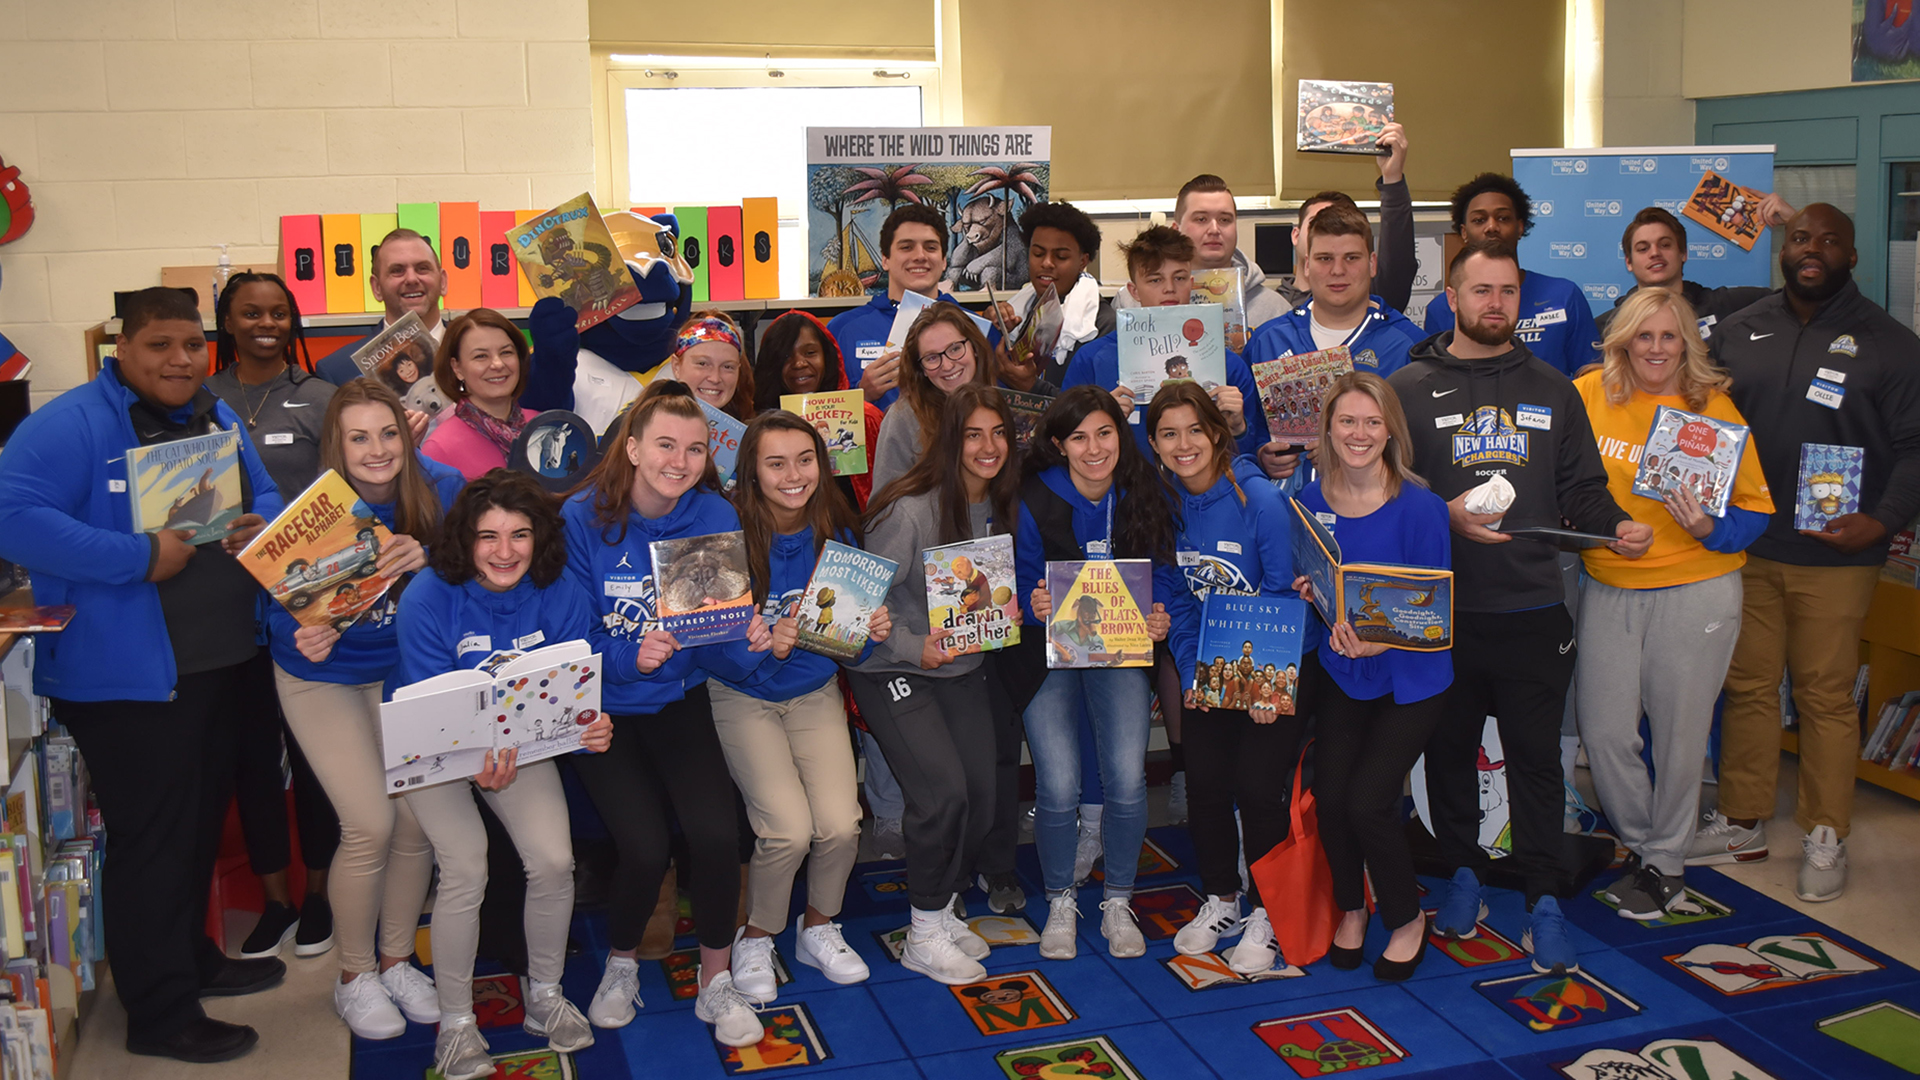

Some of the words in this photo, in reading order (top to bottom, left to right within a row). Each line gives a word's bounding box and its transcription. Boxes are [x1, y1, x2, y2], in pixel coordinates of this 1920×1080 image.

[824, 134, 875, 157] WHERE
[878, 134, 904, 157] THE
[909, 134, 944, 157] WILD
[948, 133, 1000, 156] THINGS
[1004, 133, 1033, 156] ARE
[1552, 160, 1573, 168] United
[1620, 159, 1642, 167] United
[1628, 165, 1642, 173] Way
[1585, 201, 1606, 209] United
[1655, 201, 1675, 209] United
[1593, 208, 1606, 216] Way
[517, 206, 589, 248] DINOTRUX
[1550, 243, 1571, 251] United
[1689, 244, 1710, 252] United
[1558, 250, 1571, 258] Way
[1696, 251, 1710, 259] Way
[1584, 285, 1605, 293] United
[1591, 292, 1605, 300] Way
[1125, 312, 1156, 332] Book
[361, 341, 394, 371] Snow
[393, 321, 420, 345] Bear
[1133, 336, 1145, 345] or
[1148, 334, 1181, 356] Bell?
[806, 398, 825, 406] HOW
[1688, 424, 1709, 436] ONE
[146, 449, 162, 463] THE
[165, 445, 181, 459] CAT
[183, 441, 205, 455] WHO
[207, 436, 232, 449] LIKED
[1455, 436, 1481, 457] NEW
[1486, 434, 1525, 454] HAVEN
[1597, 435, 1628, 460] LIVE
[1679, 438, 1710, 454] PIÑATA
[160, 457, 193, 474] POTATO
[196, 451, 219, 465] SOUP
[1464, 450, 1517, 464] CHARGERS
[1475, 468, 1507, 476] SOCCER
[255, 548, 267, 560] THE
[264, 492, 335, 562] RACECAR
[305, 503, 346, 546] ALPHABET
[825, 550, 894, 582] TOMORROW
[1088, 568, 1112, 580] THE
[819, 565, 850, 580] MOST
[850, 569, 888, 597] LIKELY
[610, 583, 633, 593] Emily
[1082, 582, 1119, 594] BLUES
[1110, 596, 1125, 608] OF
[1226, 603, 1254, 613] BLUE
[1259, 605, 1281, 614] SKY
[1392, 607, 1436, 616] Goodnight,
[666, 615, 715, 628] ALFRED'S
[720, 611, 747, 621] NOSE
[943, 606, 1003, 629] drawn
[1103, 609, 1138, 621] FLATS
[1394, 617, 1443, 625] Construction
[1398, 613, 1442, 622] Goodnight,
[1101, 622, 1145, 635] BROWN
[1208, 619, 1251, 630] WHITE
[1255, 622, 1296, 634] STARS
[887, 677, 912, 702] 16
